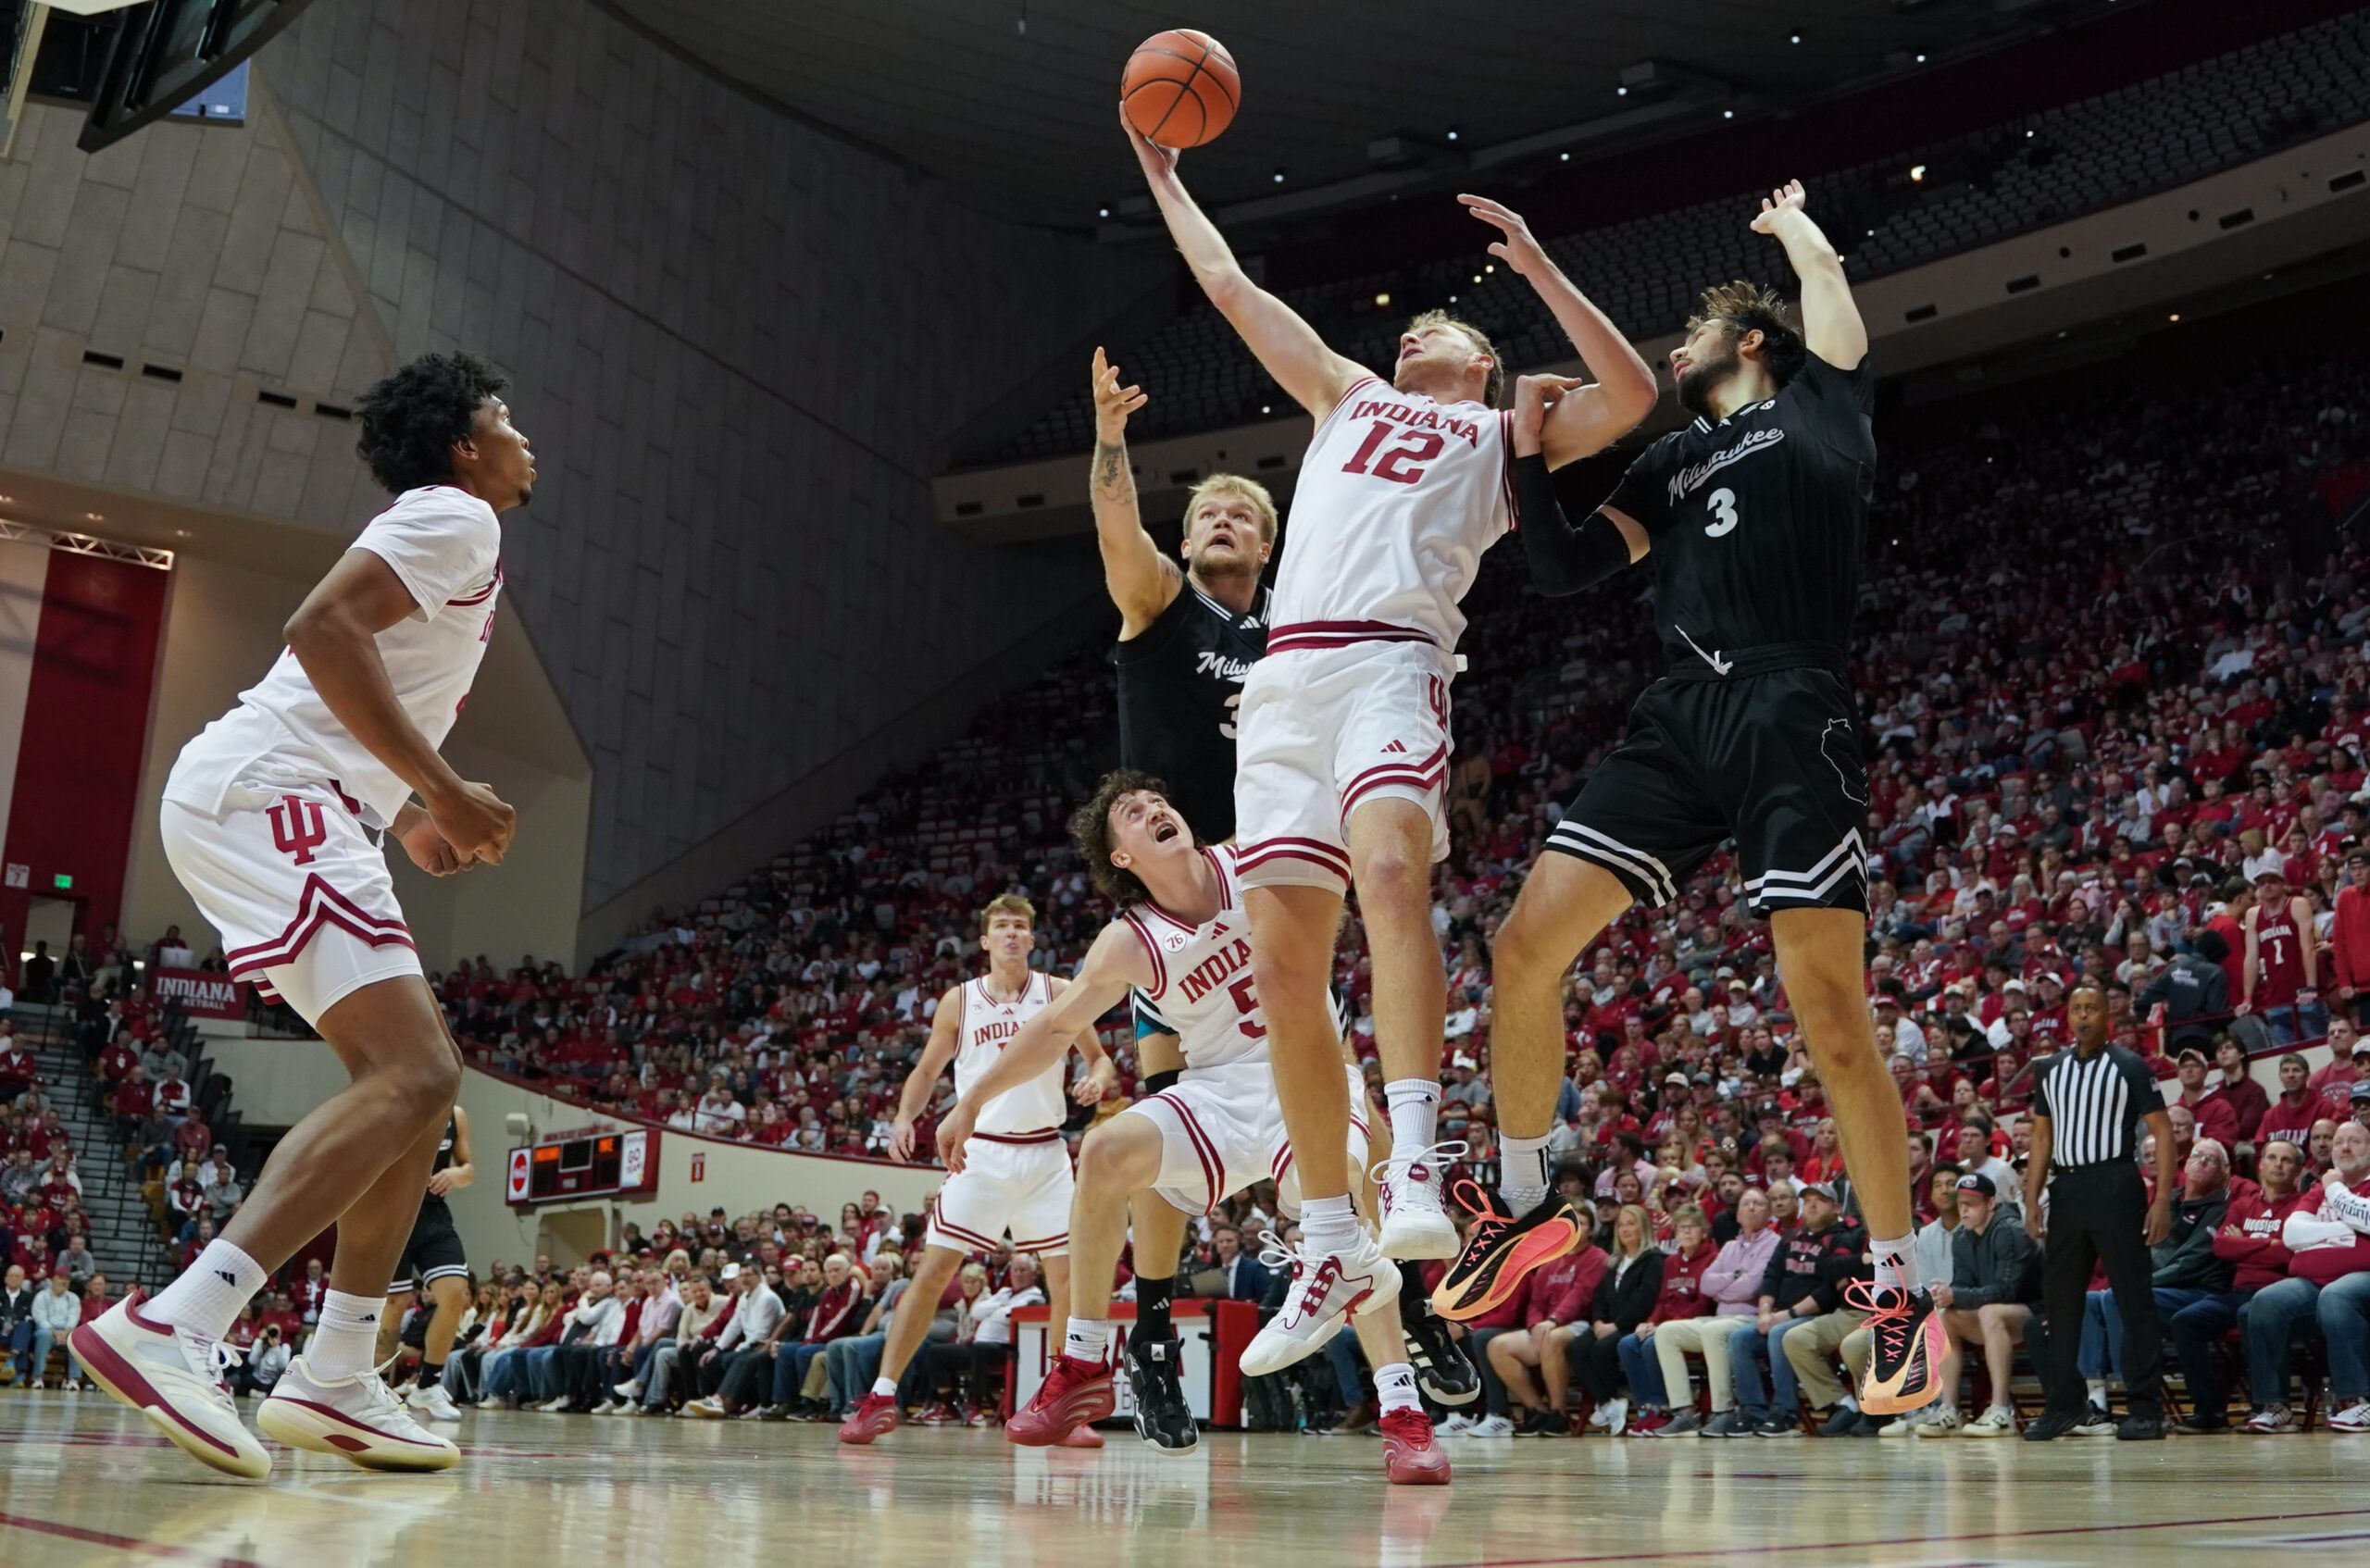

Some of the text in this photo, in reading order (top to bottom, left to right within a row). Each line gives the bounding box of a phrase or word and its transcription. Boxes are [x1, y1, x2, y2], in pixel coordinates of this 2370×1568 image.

[1349, 401, 1478, 449] INDIANA
[1341, 420, 1445, 484] 12
[1667, 428, 1786, 507] Milwaukee
[1704, 487, 1739, 538] 3
[1218, 693, 1241, 740] 3
[1166, 933, 1184, 949] 76
[2273, 939, 2285, 965] 1
[156, 976, 236, 1002] INDIANA
[1228, 975, 1267, 1039] 5
